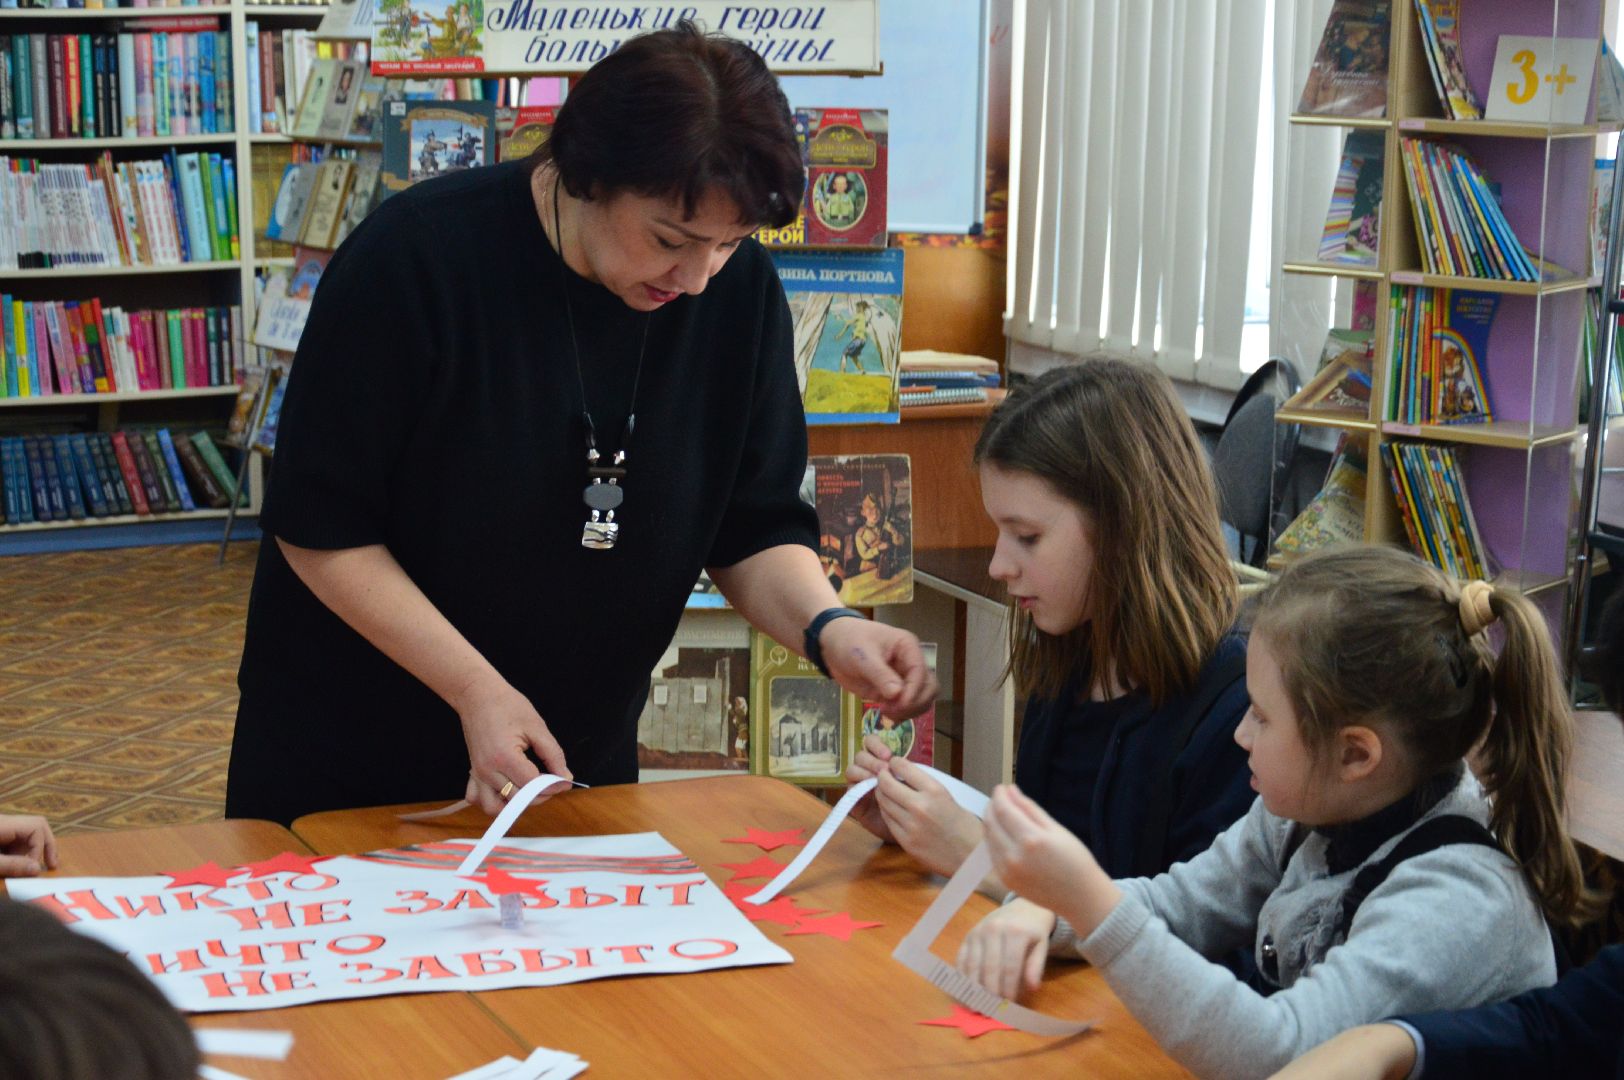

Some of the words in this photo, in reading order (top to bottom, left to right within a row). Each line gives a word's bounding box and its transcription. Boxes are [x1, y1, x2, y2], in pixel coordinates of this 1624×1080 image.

[718, 6, 826, 35] герои
[525, 33, 620, 63] боль
[1506, 49, 1577, 105] 3+
[778, 267, 817, 281] ЗИНА
[819, 269, 895, 284] ПОРТНОВА
[216, 899, 353, 932] НЕ
[127, 934, 386, 975] ИЧТО
[198, 970, 317, 998] НЕ
[339, 938, 739, 985] ЗАБЫТО
